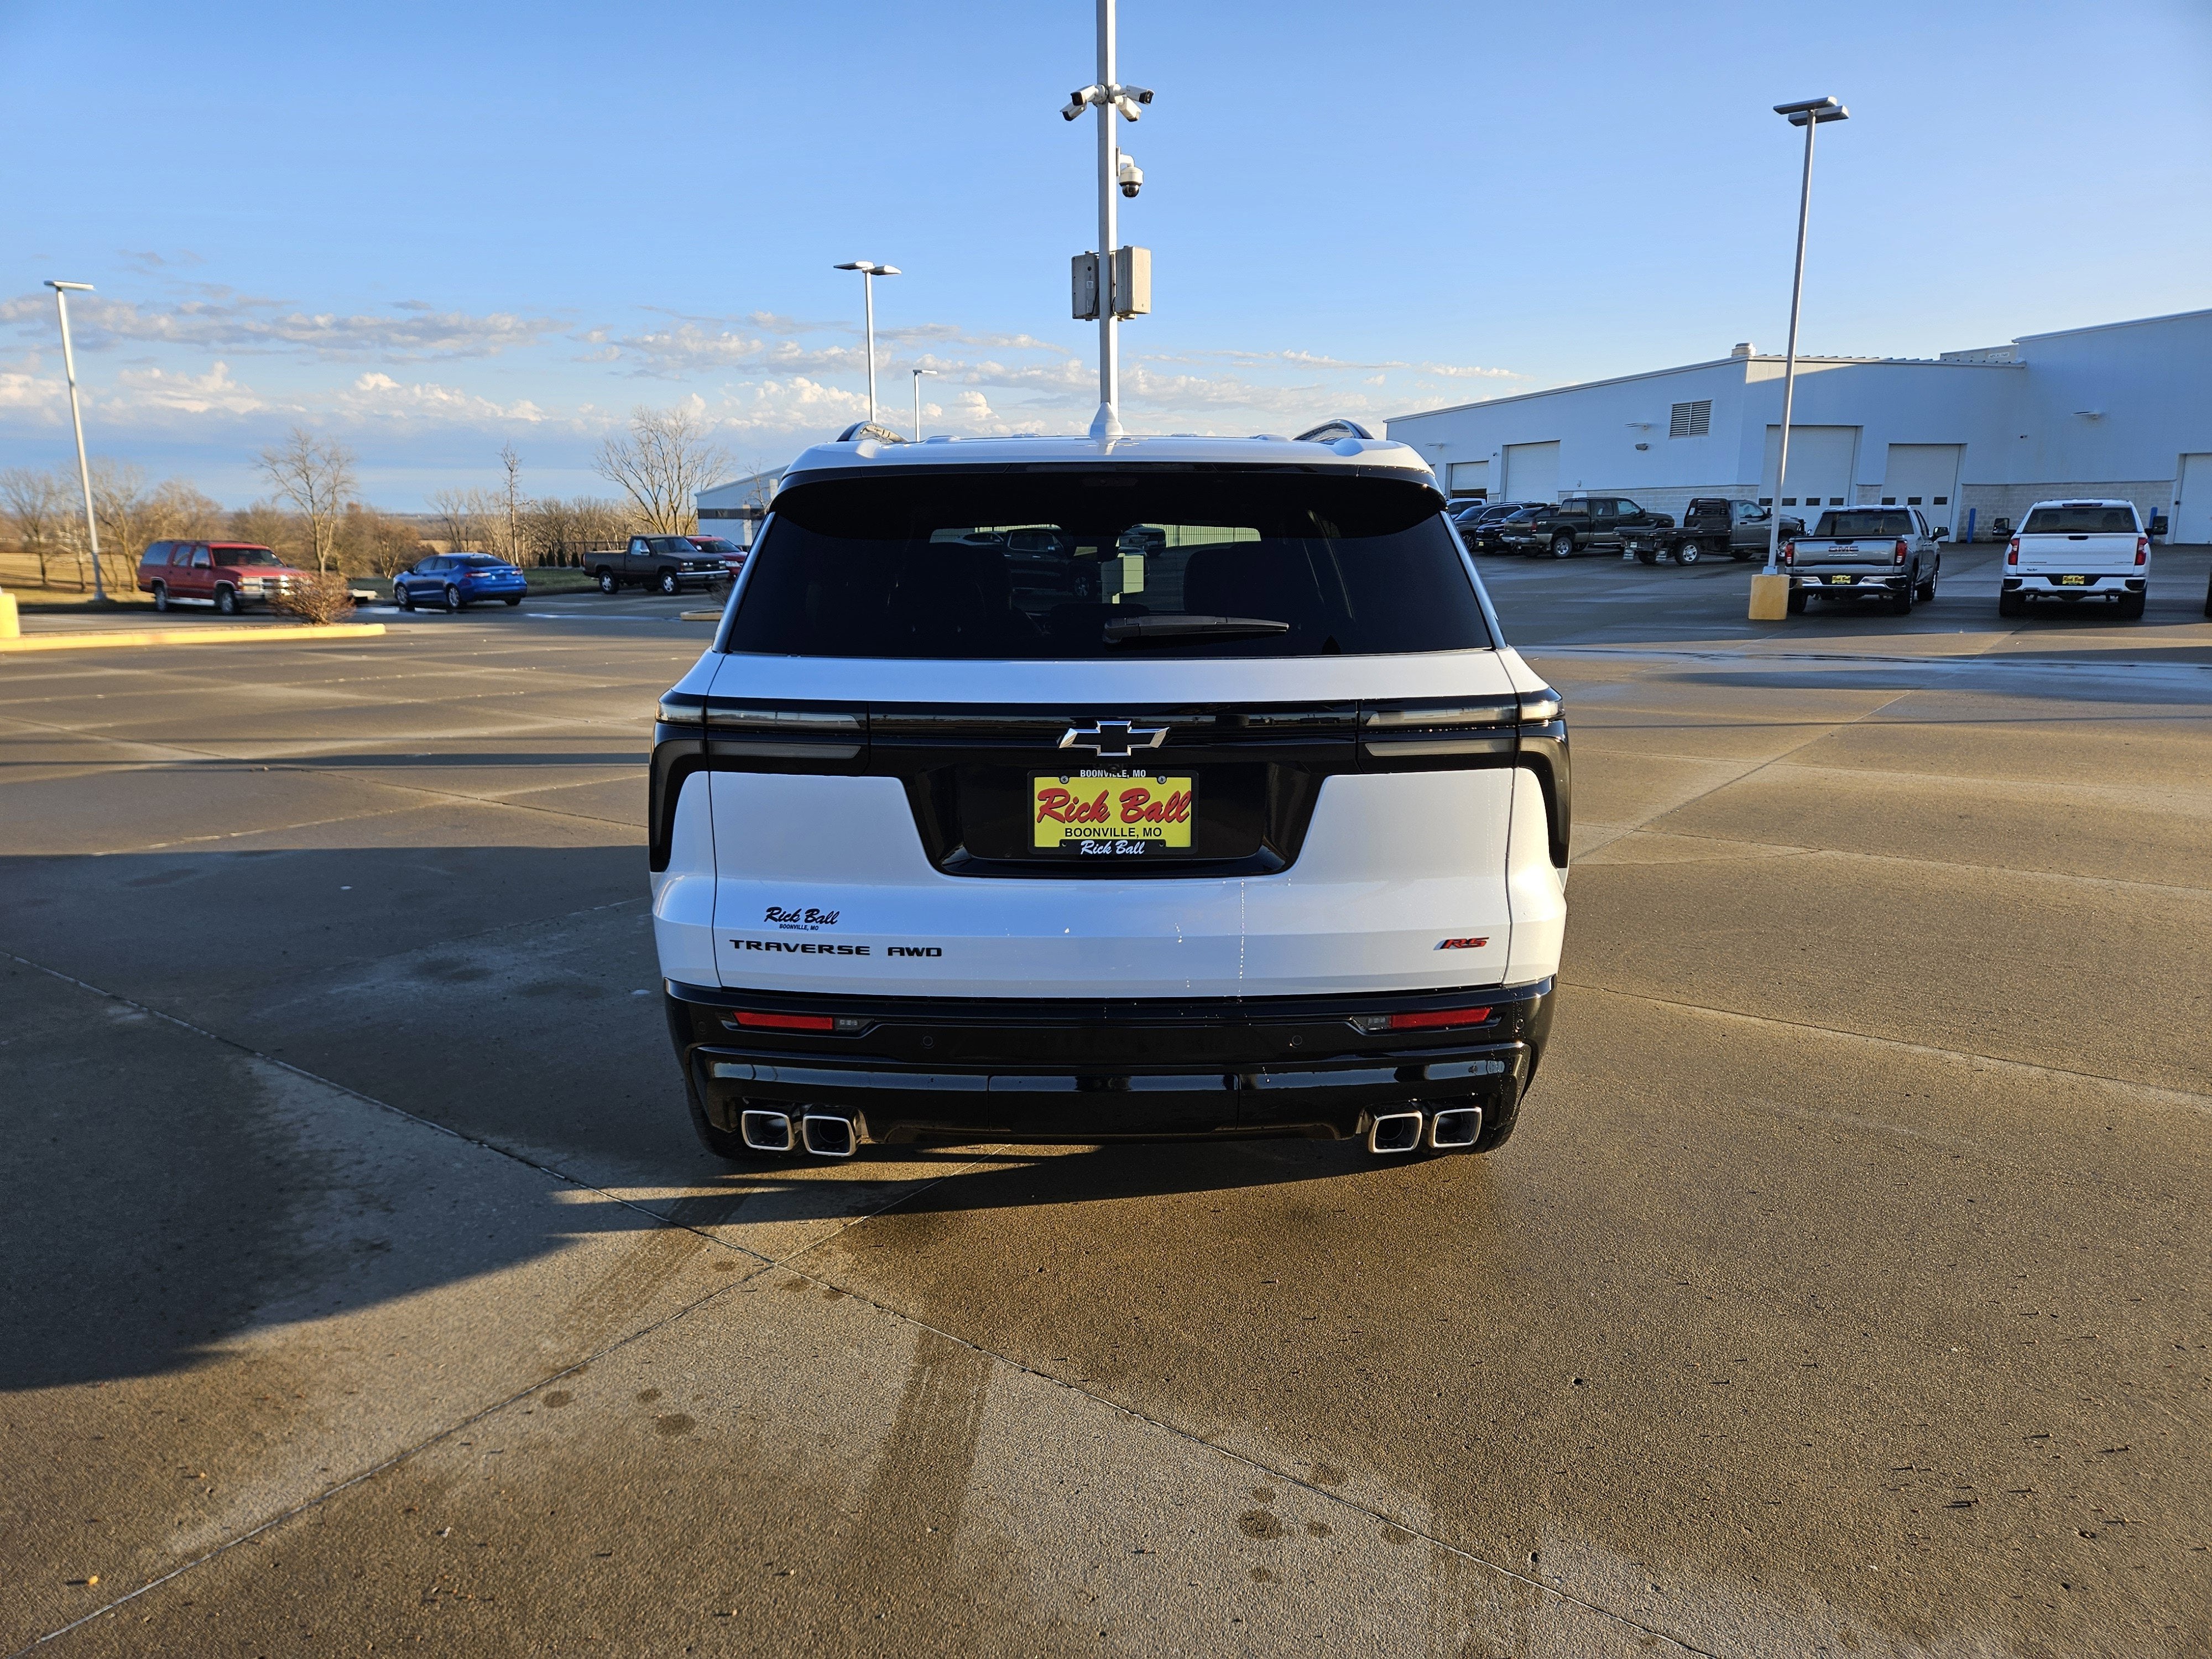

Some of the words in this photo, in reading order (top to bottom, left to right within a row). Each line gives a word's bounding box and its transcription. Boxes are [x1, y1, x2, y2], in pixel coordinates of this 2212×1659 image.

[1133, 769, 1146, 778] MO
[1037, 787, 1111, 823] Rick
[1119, 787, 1191, 823] Ball
[1065, 827, 1139, 838] BOONVILLE,
[1143, 827, 1162, 837] MO
[1081, 840, 1112, 854] Rick
[1115, 840, 1145, 854] Ball
[764, 906, 802, 923] Rick
[804, 908, 840, 925] Ball
[729, 939, 871, 956] TRAVERSE
[887, 946, 942, 957] AWD
[1439, 937, 1490, 949] RS
